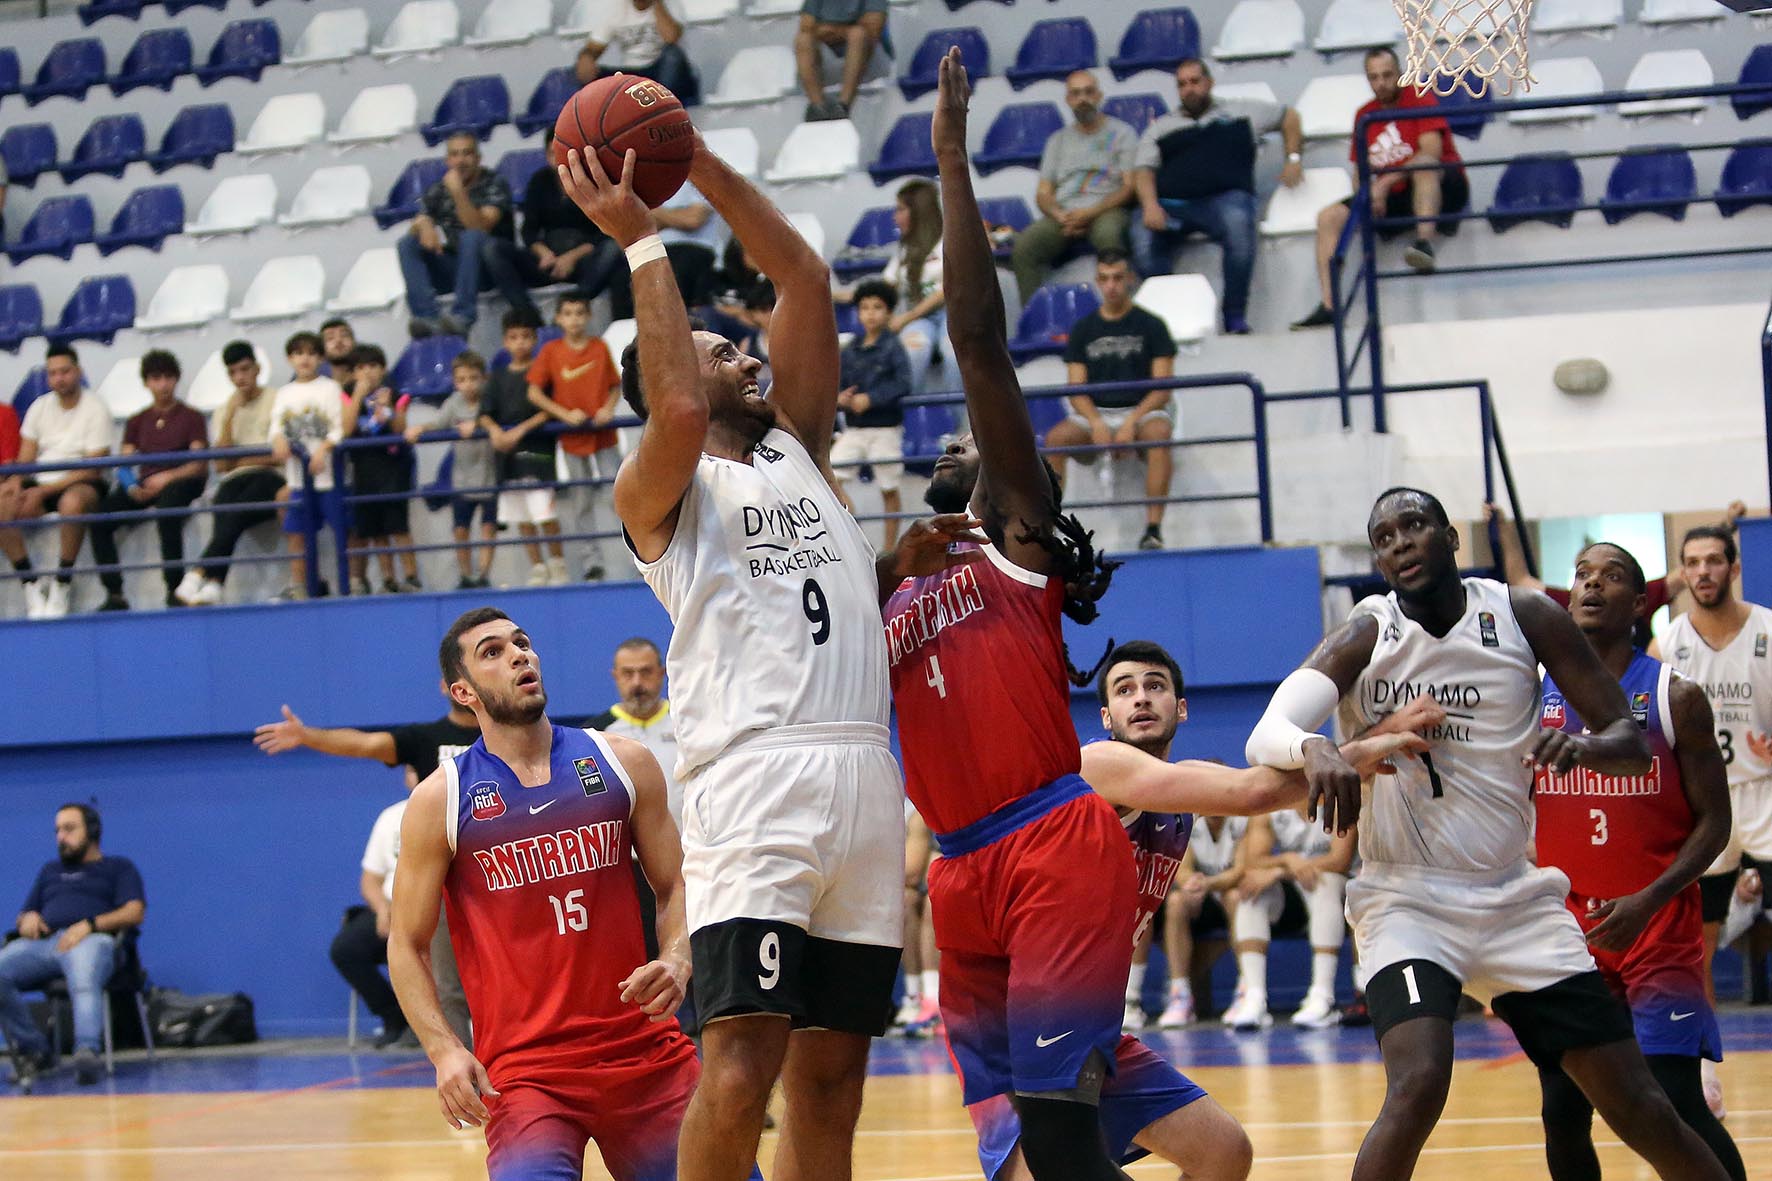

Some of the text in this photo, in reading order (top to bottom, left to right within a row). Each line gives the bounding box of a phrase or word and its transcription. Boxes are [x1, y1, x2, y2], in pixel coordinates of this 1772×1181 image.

[742, 497, 821, 540] DYNAMO
[749, 546, 842, 579] BASKETBALL
[802, 578, 831, 646] 9
[924, 654, 947, 699] 4
[1374, 678, 1481, 709] DYNAMO
[1704, 682, 1753, 699] NAMO
[1718, 729, 1735, 765] 3
[584, 775, 601, 787] FIBA
[1589, 808, 1609, 845] 3
[473, 820, 623, 891] ANTRANIK
[548, 888, 588, 935] 15
[758, 931, 781, 990] 9
[1402, 965, 1421, 1005] 1
